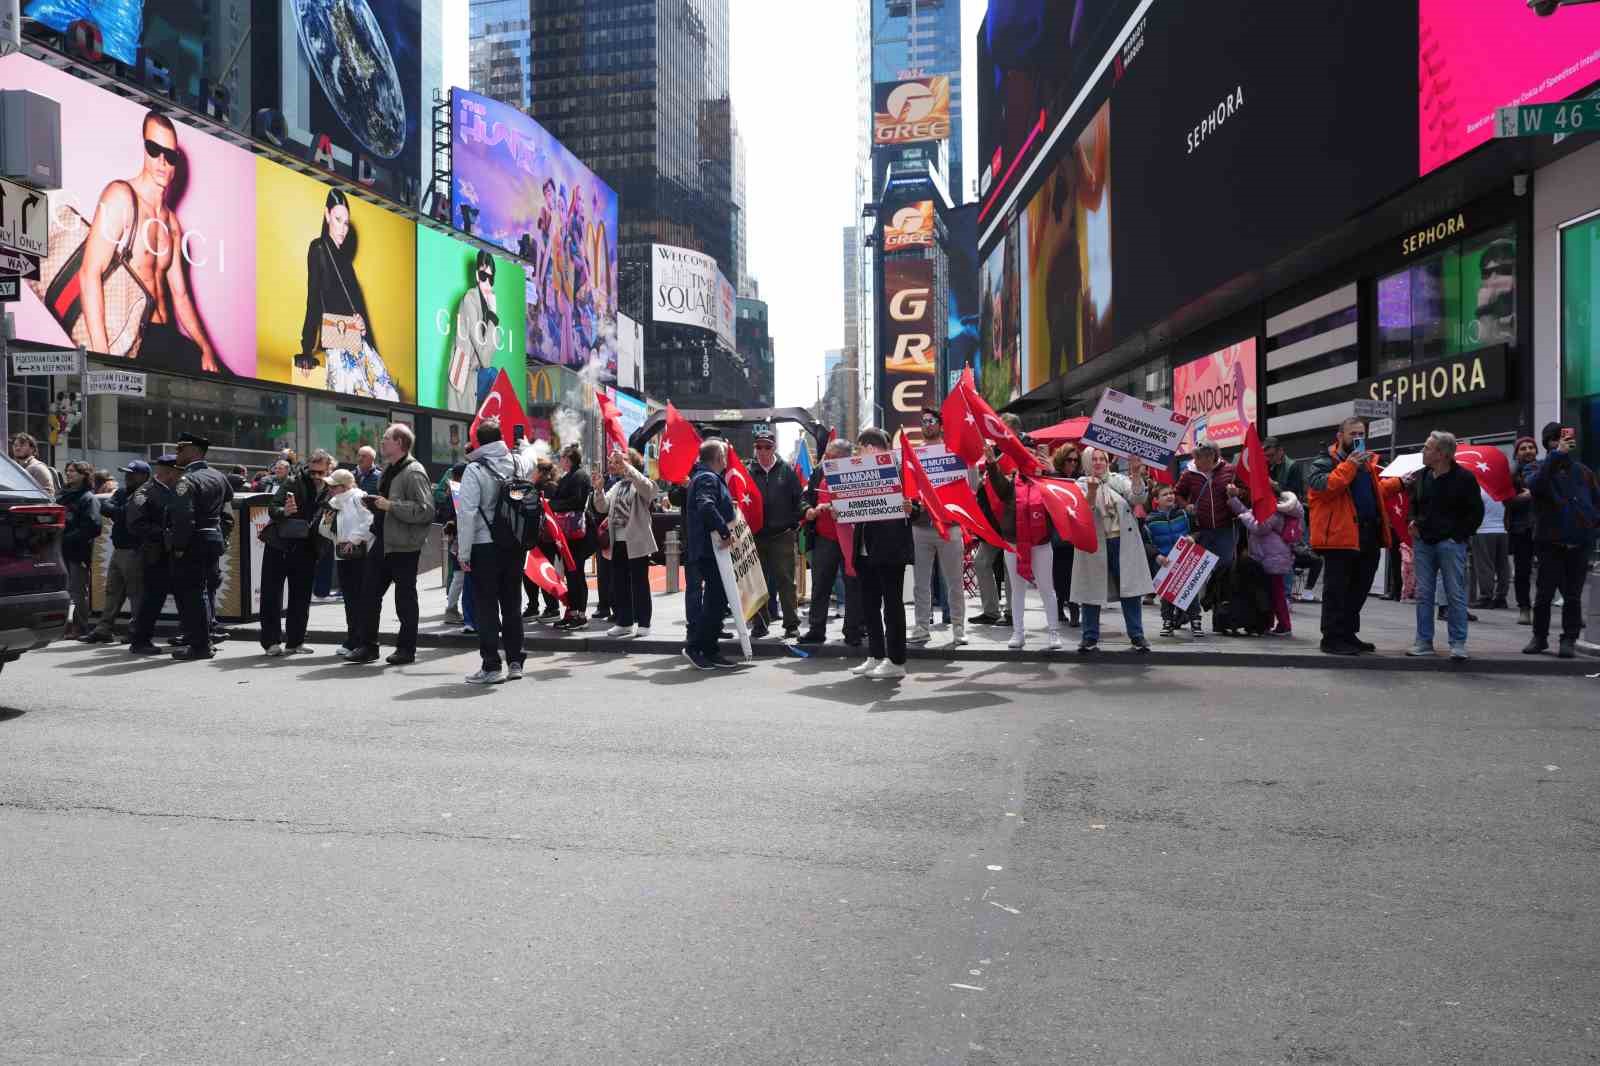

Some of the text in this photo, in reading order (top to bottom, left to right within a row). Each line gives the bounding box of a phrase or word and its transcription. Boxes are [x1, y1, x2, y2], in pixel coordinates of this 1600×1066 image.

[1123, 17, 1147, 57] MARRIOTT
[1546, 64, 1579, 88] Speedtest
[876, 121, 945, 140] GREE
[1187, 85, 1243, 154] SEPHORA
[1523, 109, 1543, 133] W
[1555, 105, 1583, 129] 46
[19, 236, 42, 251] ONLY
[52, 191, 224, 273] GUCCI
[886, 232, 933, 245] GREE
[1402, 213, 1465, 256] SEPHORA
[7, 257, 30, 272] WAY
[436, 308, 513, 352] GUCCI
[1369, 358, 1486, 406] SEPHORA
[1185, 381, 1239, 417] PANDORA
[1104, 416, 1141, 436] MUSLIM
[1140, 428, 1169, 445] TURKS
[1096, 433, 1111, 444] OF
[1110, 436, 1161, 461] GENOCIDE
[927, 456, 957, 468] MUTES
[839, 469, 881, 484] MAMDANI
[848, 498, 888, 509] ARMENIAN
[855, 508, 869, 516] NOT
